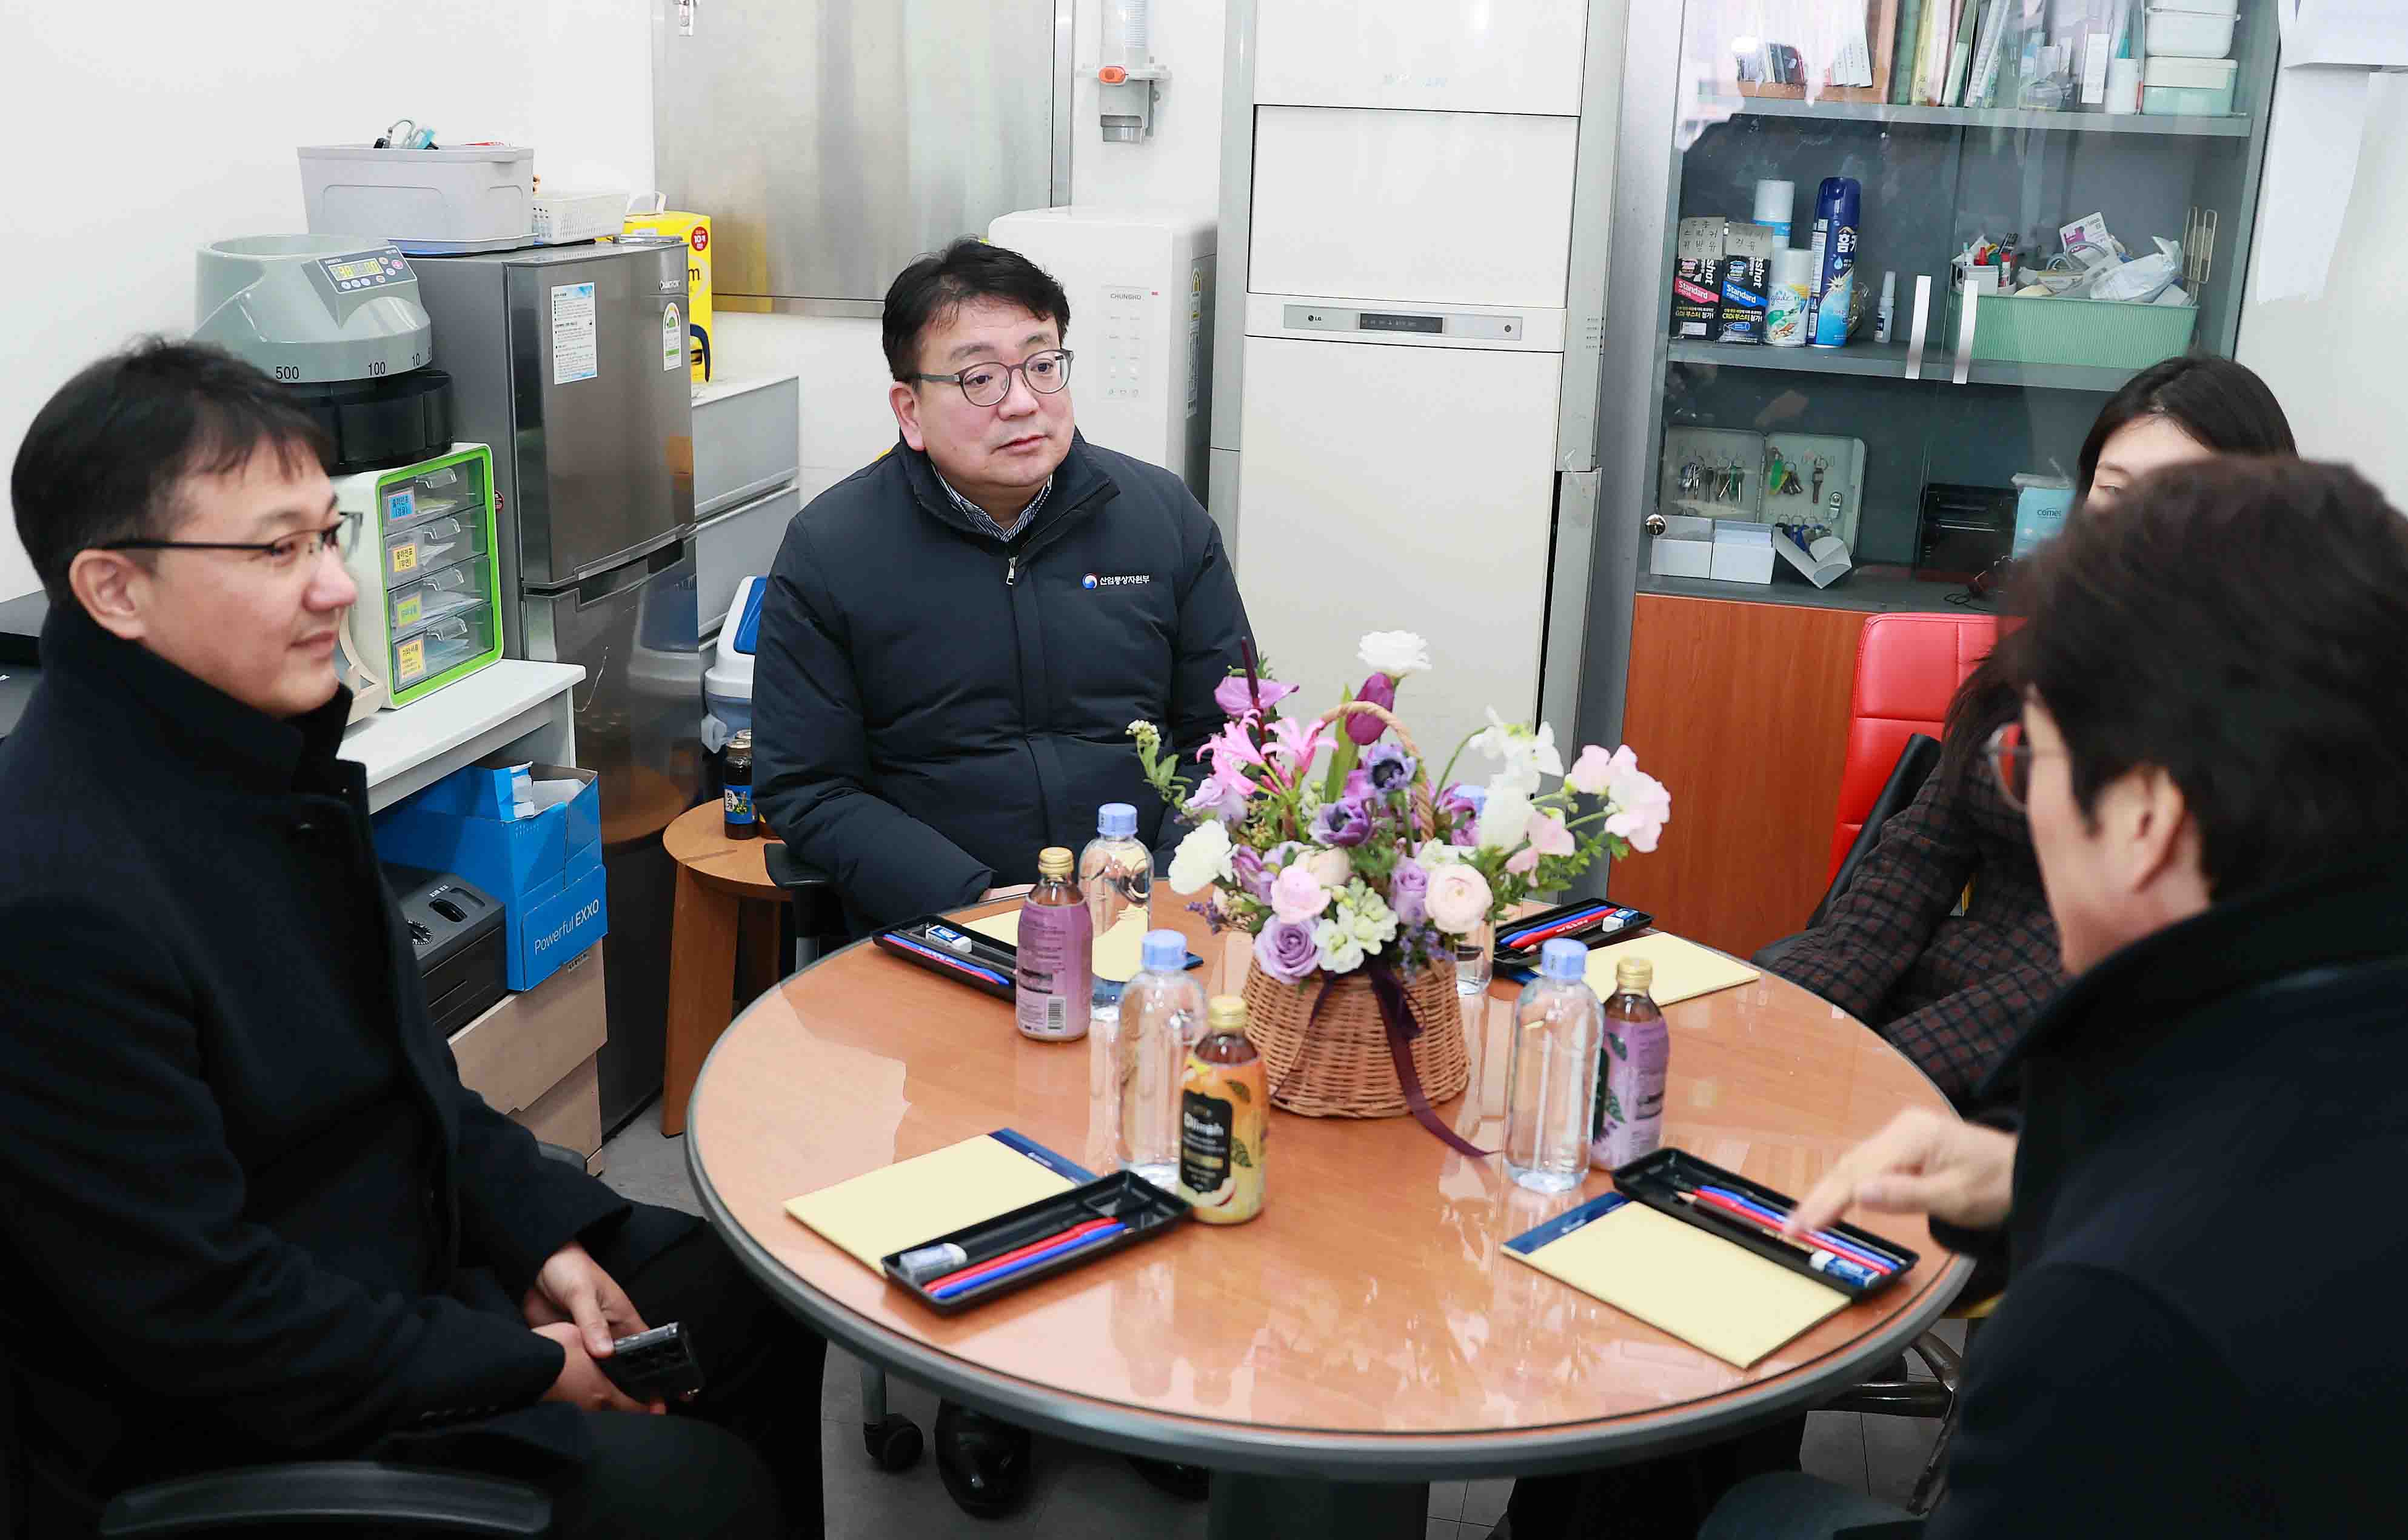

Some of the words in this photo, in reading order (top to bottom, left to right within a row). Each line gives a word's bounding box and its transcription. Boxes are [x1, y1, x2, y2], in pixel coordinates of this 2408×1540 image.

[1678, 281, 1708, 299] Standard
[1727, 284, 1756, 303] Standard
[412, 353, 420, 367] 10
[276, 366, 299, 379] 500
[368, 361, 386, 376] 100
[1099, 575, 1150, 586] 산업통상자원부
[534, 916, 574, 956] Powerful
[575, 898, 599, 927] EXXO
